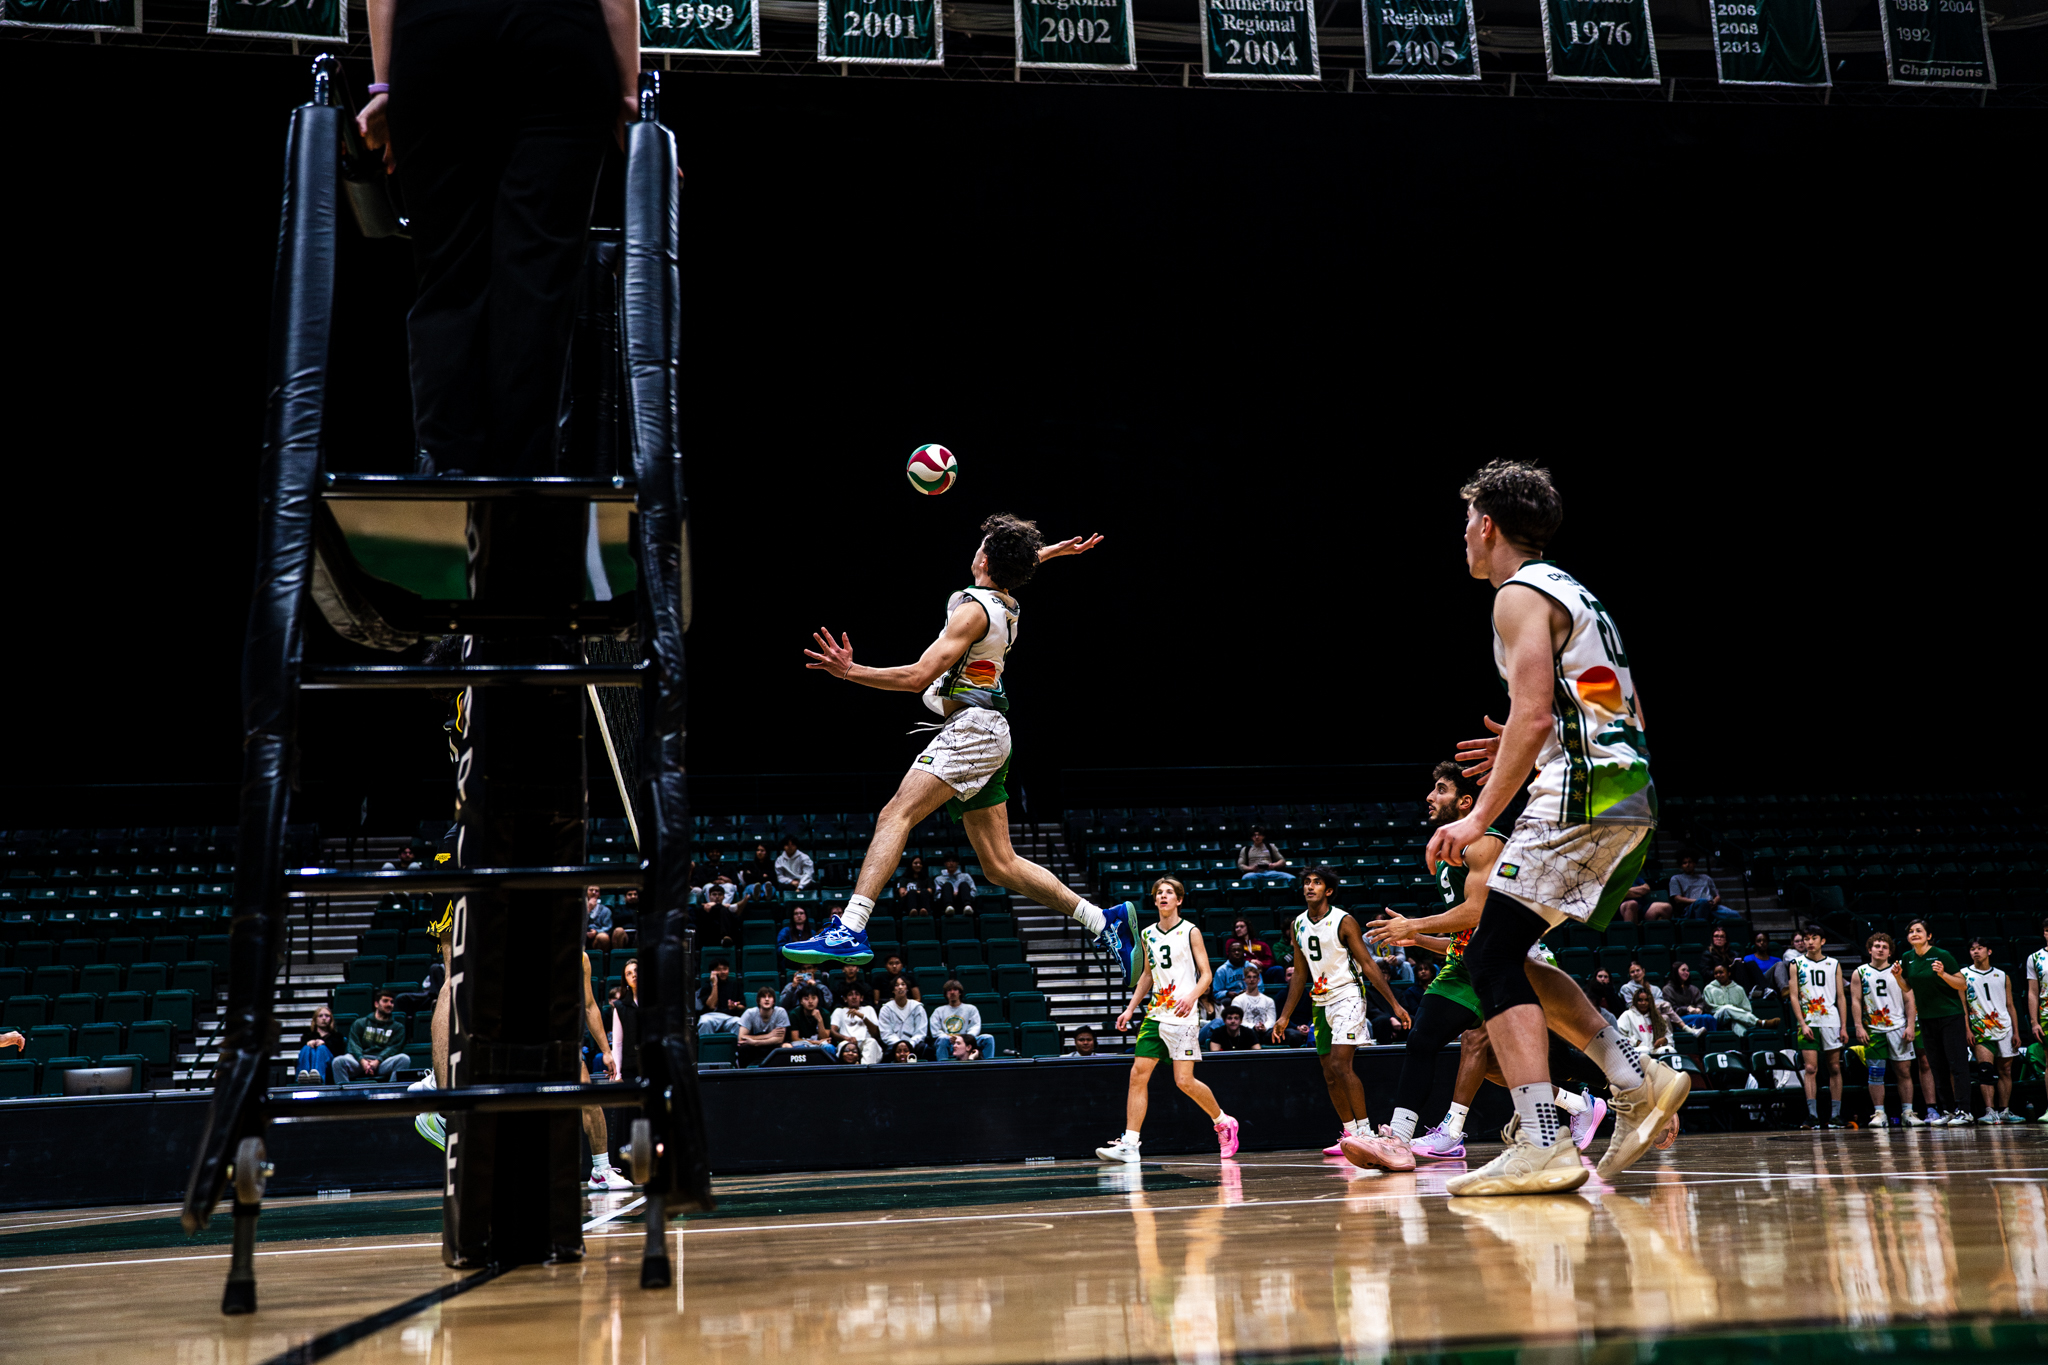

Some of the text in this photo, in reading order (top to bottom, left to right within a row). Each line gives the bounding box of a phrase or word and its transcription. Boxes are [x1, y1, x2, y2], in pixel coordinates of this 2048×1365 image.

[655, 2, 734, 30] 1999
[1717, 4, 1757, 16] 2006
[1896, 0, 1975, 13] 1988 2004
[843, 10, 919, 39] 2001
[1221, 13, 1296, 35] Regional
[1382, 8, 1455, 29] Regional
[1040, 17, 1111, 44] 2002
[1566, 20, 1632, 46] 1976
[1719, 22, 1759, 35] 2008
[1897, 27, 1931, 42] 1992
[1225, 39, 1298, 66] 2004
[1386, 40, 1459, 66] 2005
[1722, 41, 1761, 53] 2013
[1900, 64, 1983, 78] Champions
[1159, 944, 1172, 969] 3
[1308, 935, 1322, 961] 9
[1809, 969, 1826, 987] 10
[1876, 978, 1888, 997] 2
[1983, 982, 1991, 1001] 1
[790, 1054, 807, 1063] POSS
[1716, 1053, 1728, 1068] C
